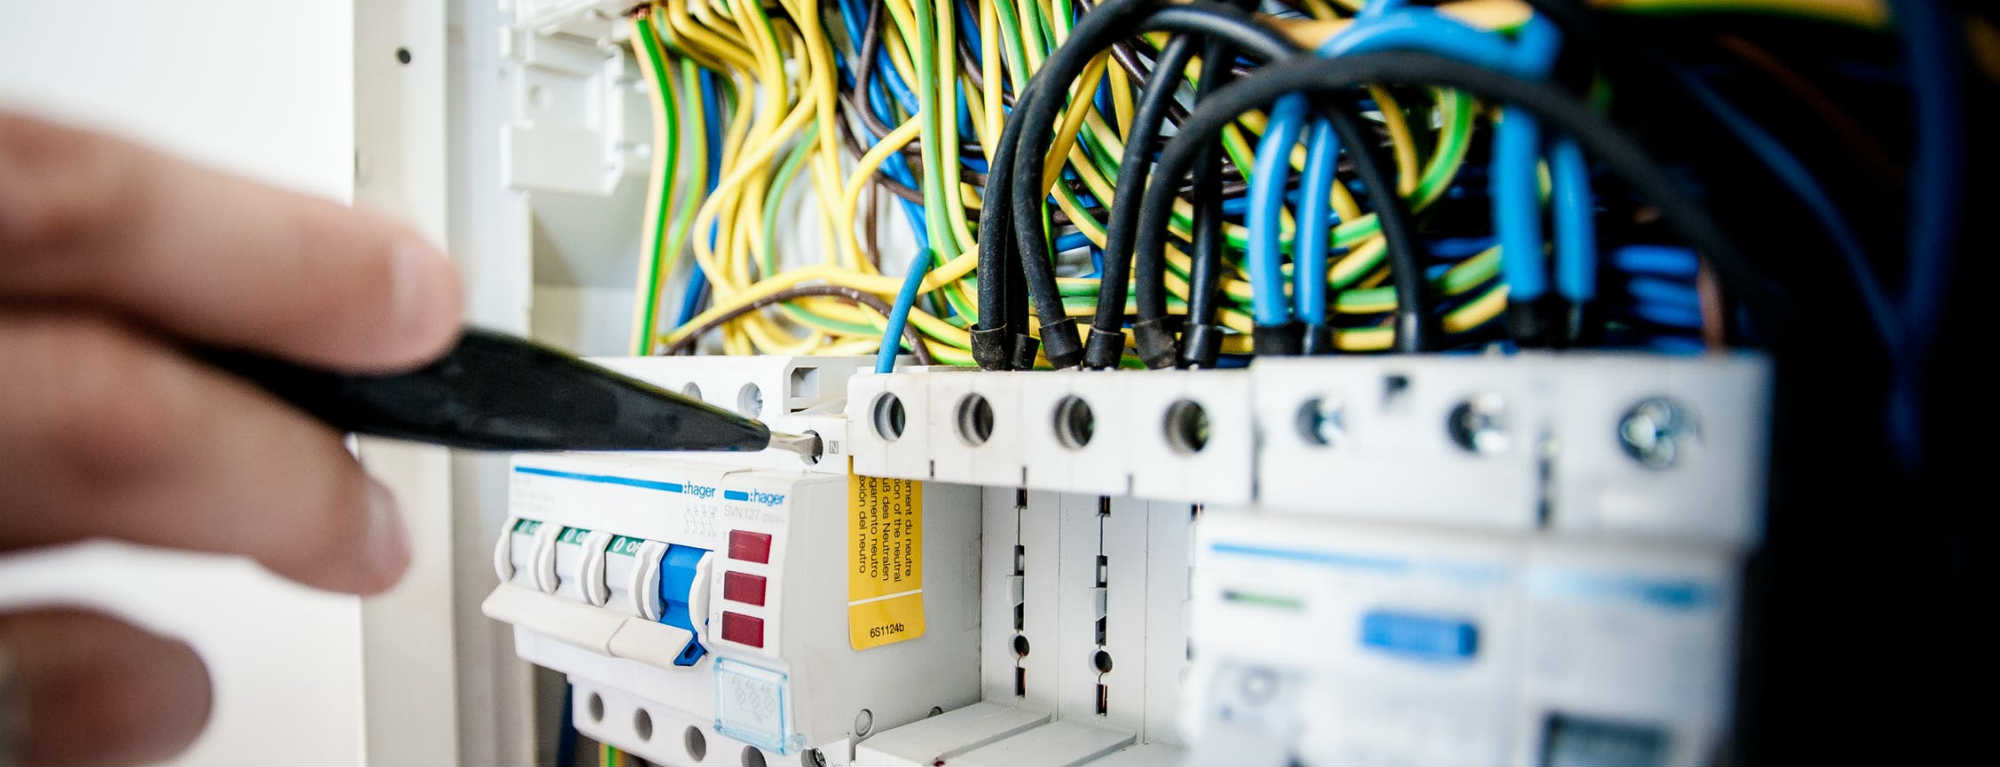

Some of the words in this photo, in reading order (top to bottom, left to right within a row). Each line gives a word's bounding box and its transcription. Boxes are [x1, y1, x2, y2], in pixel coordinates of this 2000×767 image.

[869, 475, 877, 534] gamento
[882, 496, 890, 518] des
[893, 506, 902, 516] of
[859, 510, 867, 530] del
[893, 518, 902, 538] the
[905, 520, 912, 535] du
[870, 538, 878, 578] neutro
[882, 522, 891, 581] Neutralen
[893, 541, 902, 582] neutral
[870, 623, 904, 638] 6S1124b
